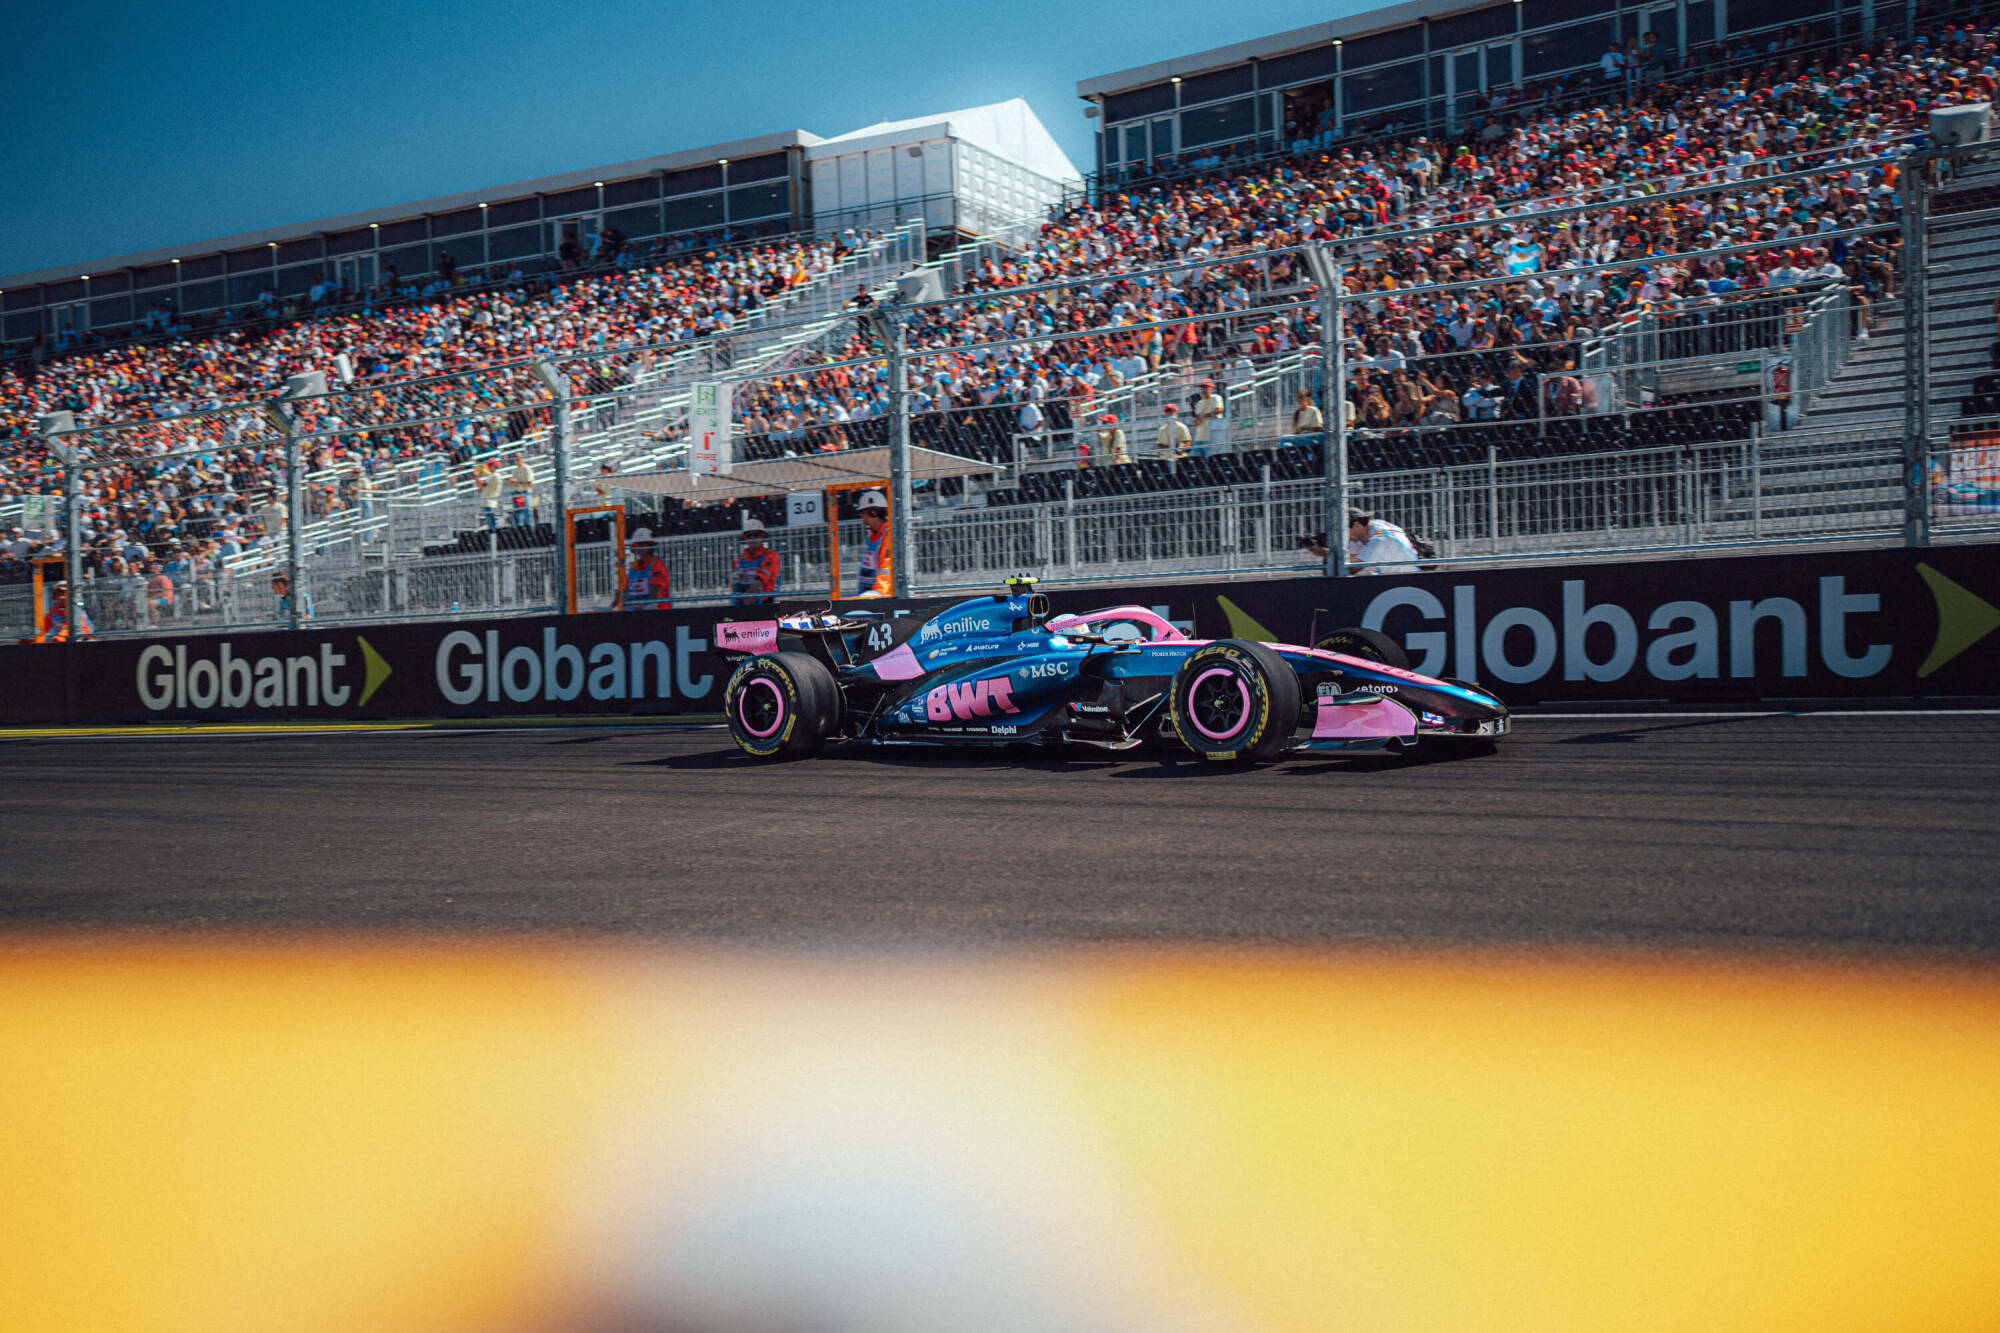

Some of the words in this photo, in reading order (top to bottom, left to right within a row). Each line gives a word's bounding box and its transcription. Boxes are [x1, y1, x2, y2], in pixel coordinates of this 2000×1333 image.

[793, 501, 816, 514] 3.0
[741, 629, 770, 639] enilive
[943, 617, 990, 633] enilive
[1361, 576, 1894, 684] Globant
[868, 623, 893, 651] 43
[435, 625, 713, 705] Globant
[1031, 662, 1069, 678] MSC
[136, 642, 351, 711] Globant
[926, 677, 1020, 722] BWT
[992, 725, 1017, 736] Delphi
